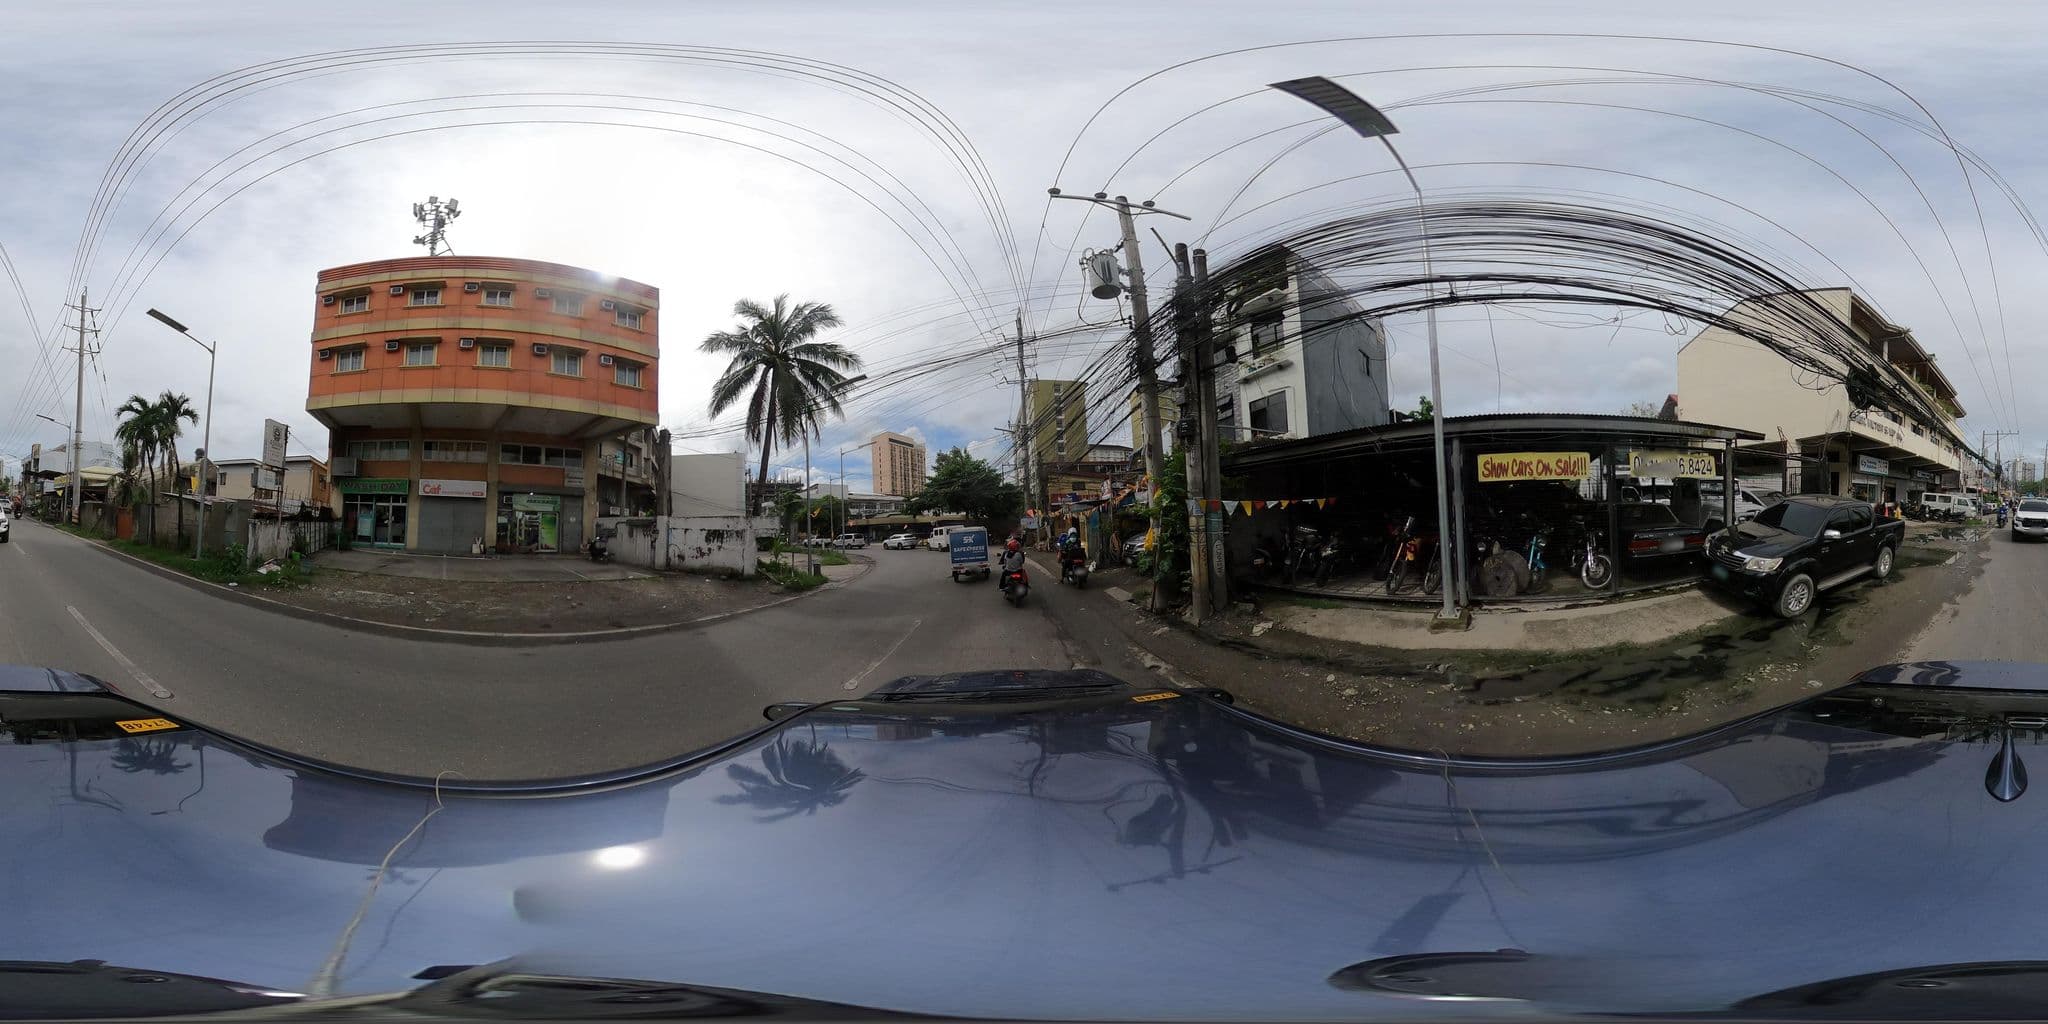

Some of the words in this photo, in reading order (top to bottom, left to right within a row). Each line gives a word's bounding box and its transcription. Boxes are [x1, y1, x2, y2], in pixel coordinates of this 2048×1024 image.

[1482, 457, 1509, 478] Show
[1511, 458, 1534, 477] Cars
[1535, 459, 1553, 476] On
[1554, 456, 1587, 477] Sale!!!
